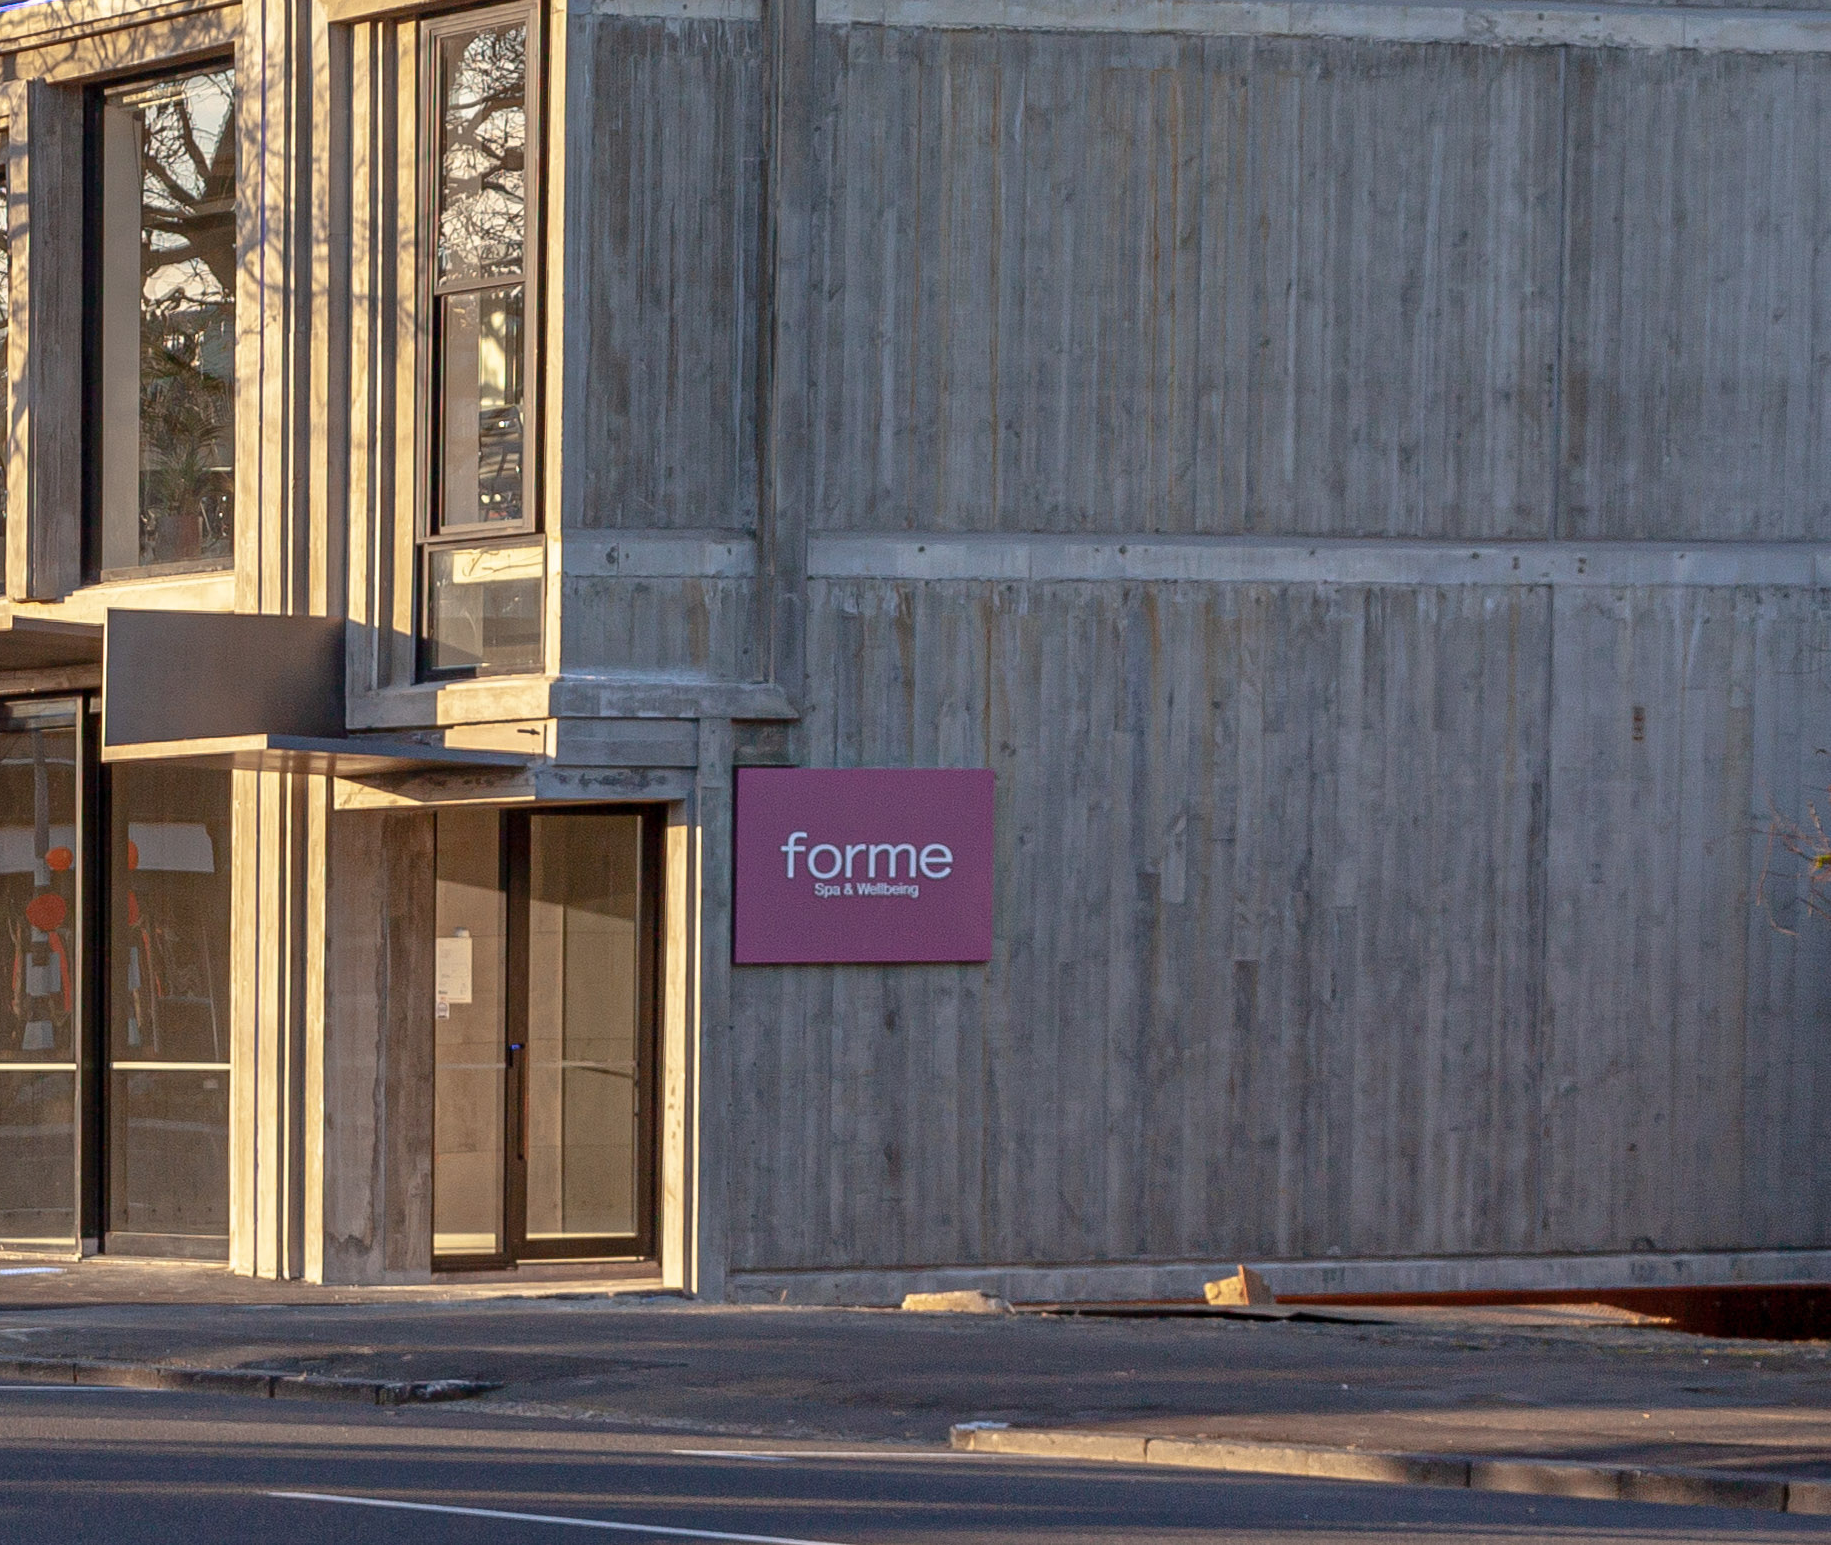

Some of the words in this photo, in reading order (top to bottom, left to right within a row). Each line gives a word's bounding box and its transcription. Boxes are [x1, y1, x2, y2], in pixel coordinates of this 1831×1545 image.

[780, 831, 954, 880] forme
[814, 882, 840, 898] Spa
[843, 883, 854, 896] &
[857, 882, 920, 898] Wellbeing
